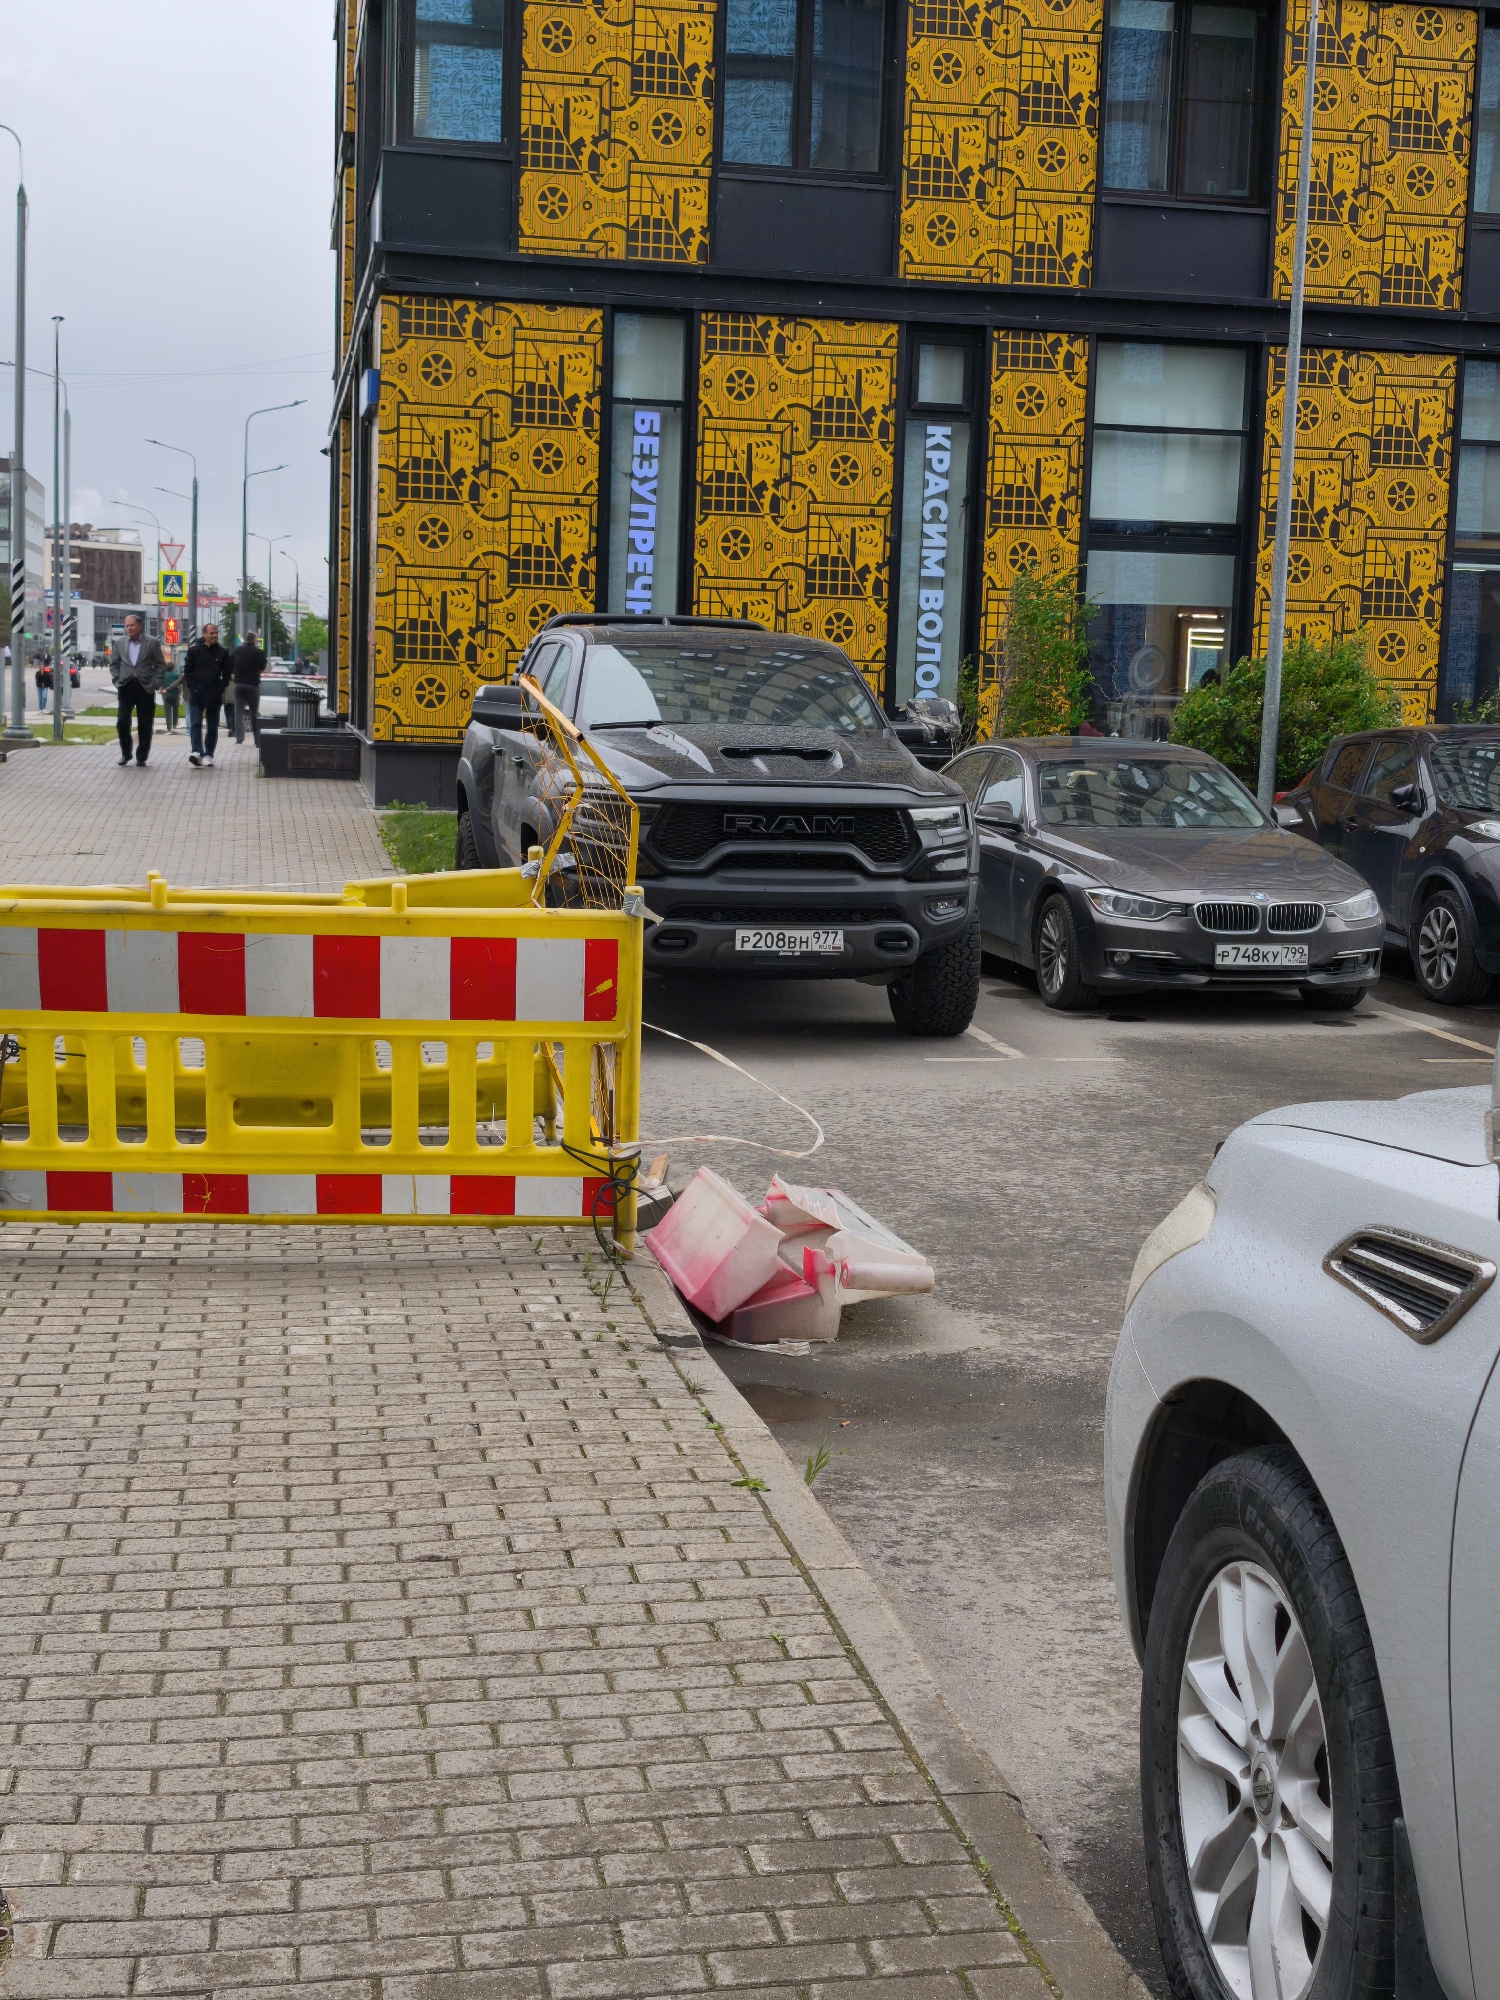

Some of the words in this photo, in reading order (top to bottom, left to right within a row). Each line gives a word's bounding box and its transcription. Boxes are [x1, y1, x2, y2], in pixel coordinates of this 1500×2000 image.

[919, 425, 952, 578] КРАСИМ
[723, 814, 855, 834] RAM
[740, 931, 809, 950] Р208ВН
[812, 931, 839, 945] 977
[1282, 946, 1305, 959] 799
